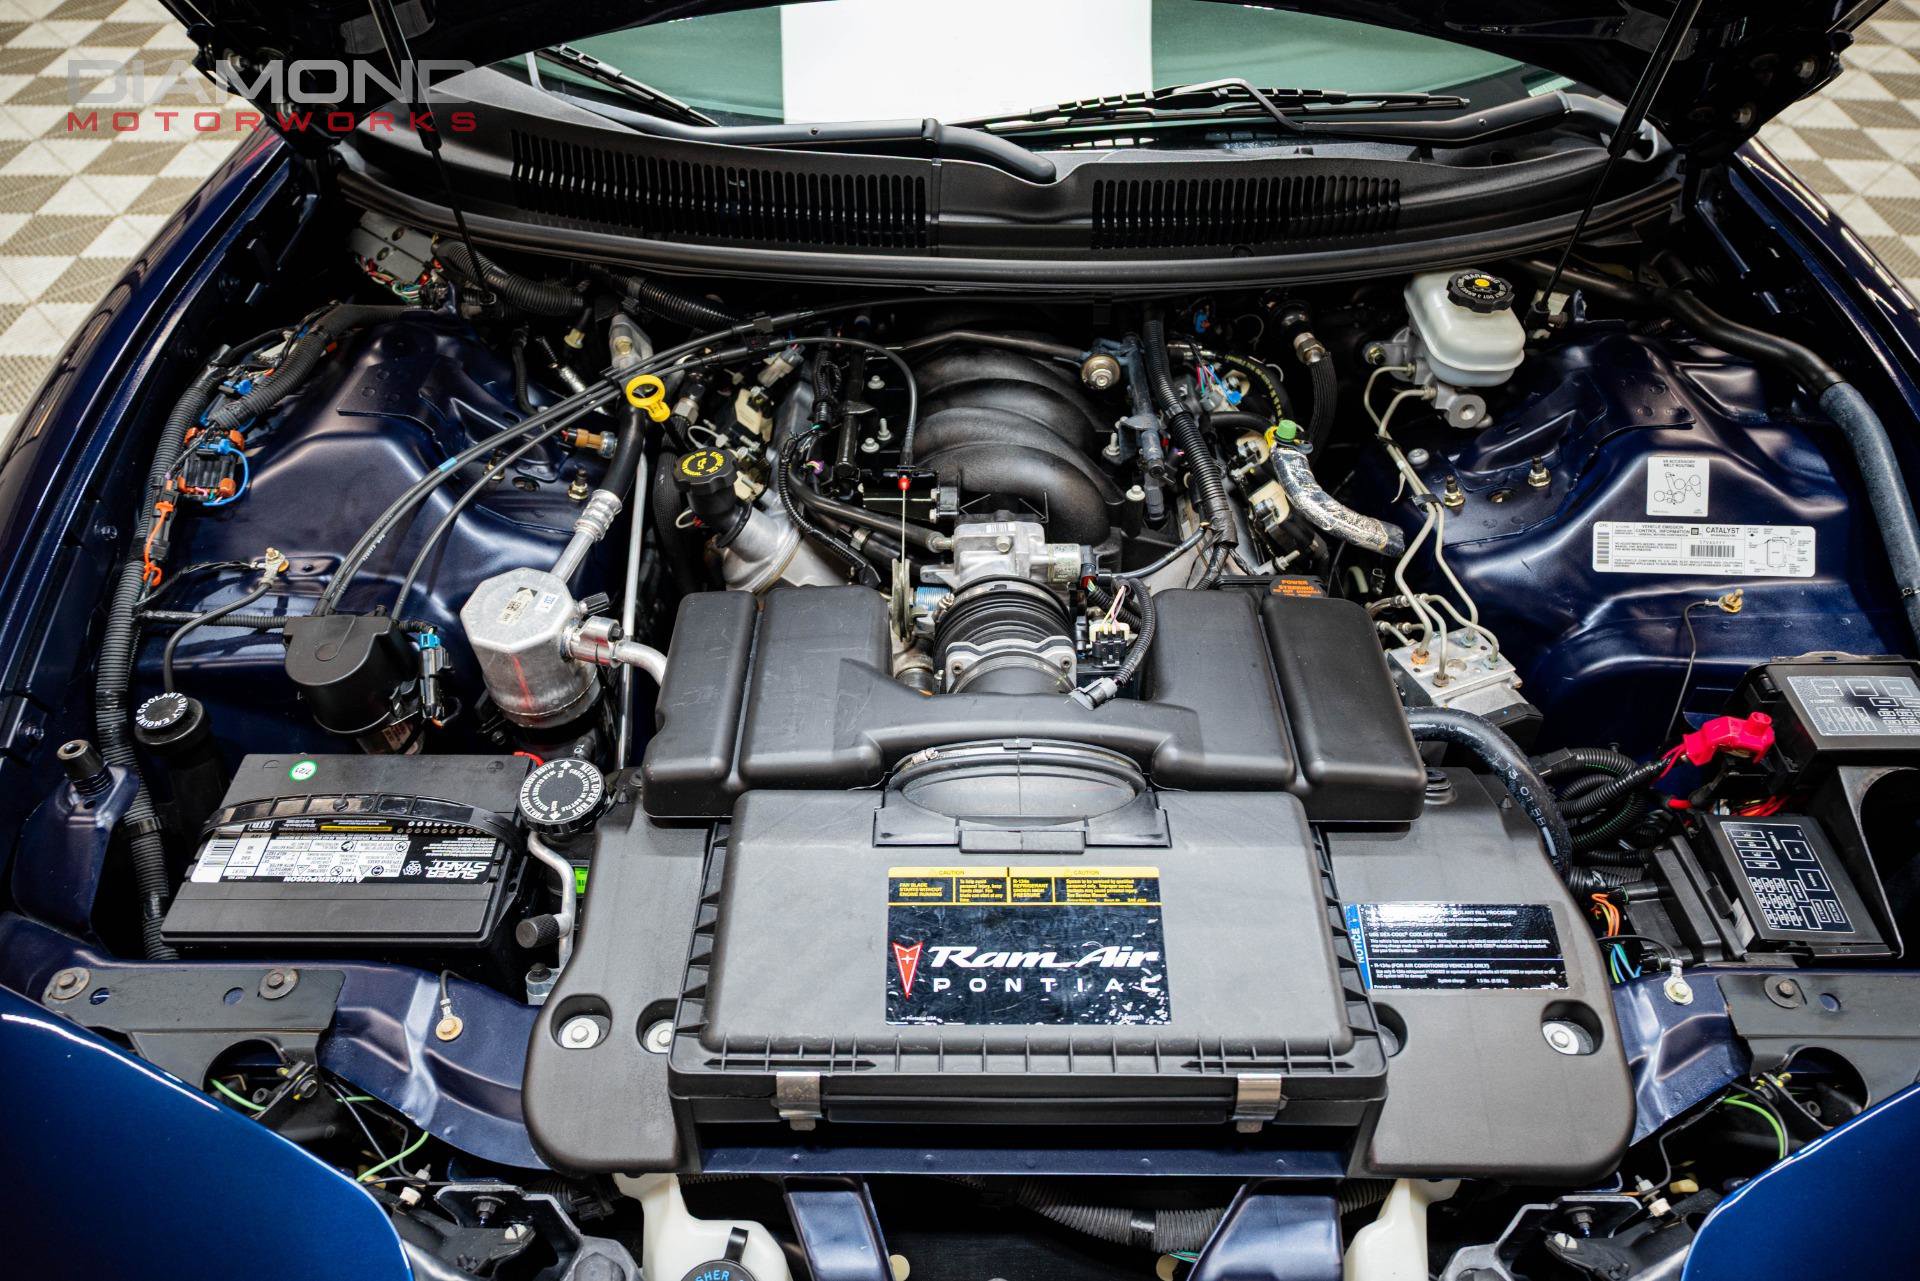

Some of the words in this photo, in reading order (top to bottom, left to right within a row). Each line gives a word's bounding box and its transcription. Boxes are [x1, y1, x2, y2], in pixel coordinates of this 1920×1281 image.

[136, 692, 183, 713] COOLANT
[172, 698, 187, 718] ONLY
[136, 714, 170, 727] ENGINE
[580, 763, 600, 783] NEVER
[586, 784, 600, 803] OPEN
[572, 802, 589, 816] HOT
[425, 869, 479, 879] SUPER
[429, 861, 490, 872] START
[1350, 928, 1365, 963] NOTICE
[928, 946, 1078, 968] Ram
[1075, 946, 1161, 968] Air
